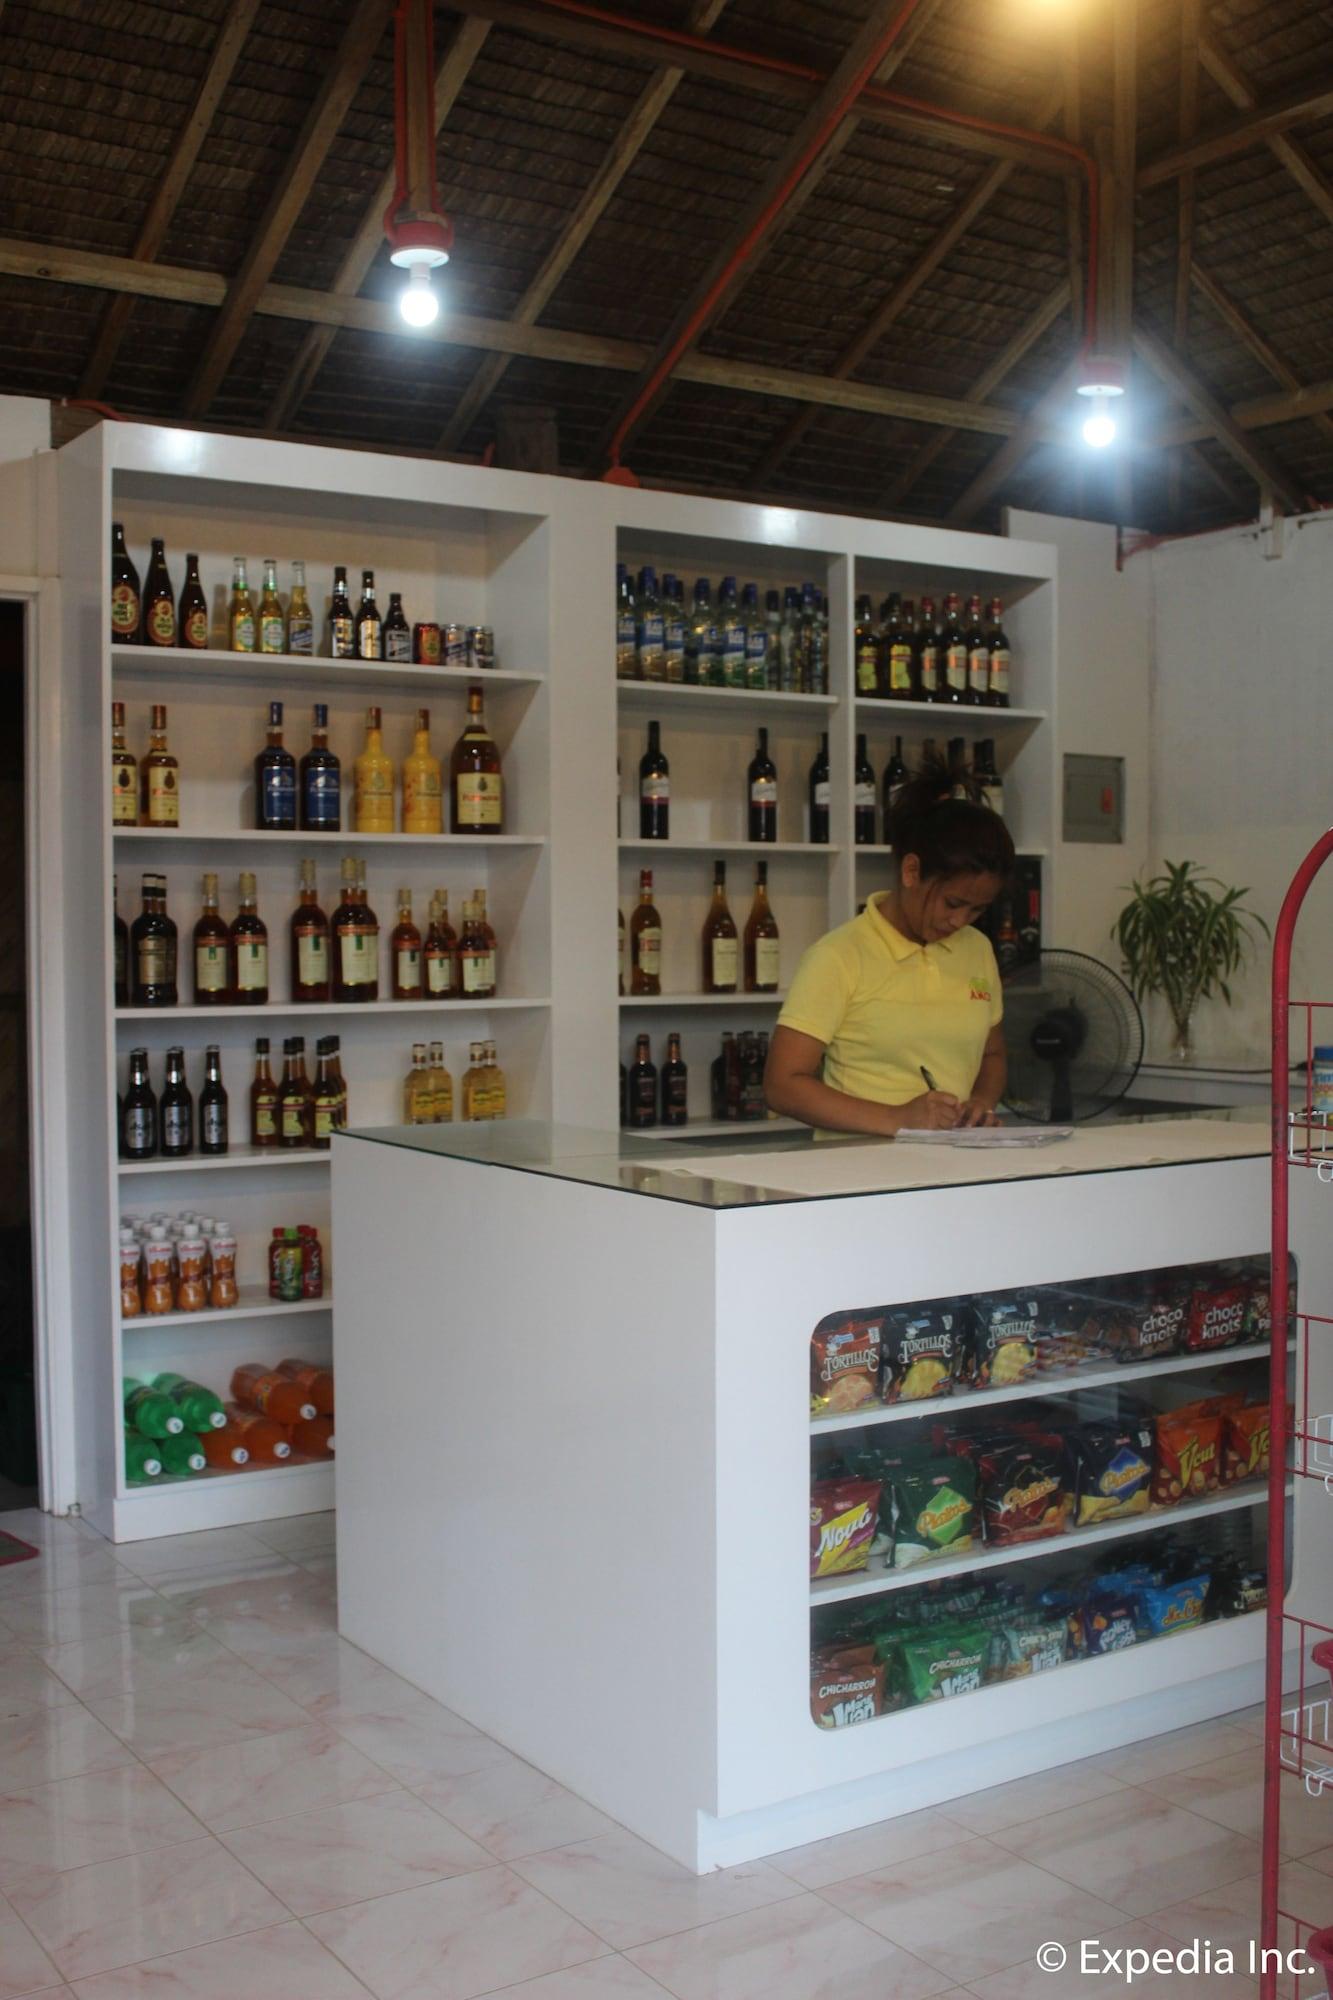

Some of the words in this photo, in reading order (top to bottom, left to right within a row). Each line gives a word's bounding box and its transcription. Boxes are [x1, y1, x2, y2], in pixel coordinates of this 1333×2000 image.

[1142, 1308, 1183, 1332] choco
[1203, 1318, 1241, 1340] knots
[987, 1320, 1037, 1349] TORTILLOS
[1139, 1323, 1178, 1345] knots
[898, 1334, 952, 1364] TORTILLOS
[820, 1348, 880, 1381] TORTILLOS
[929, 1654, 982, 1674] CHICHARRON
[819, 1678, 876, 1698] CHICHARRON
